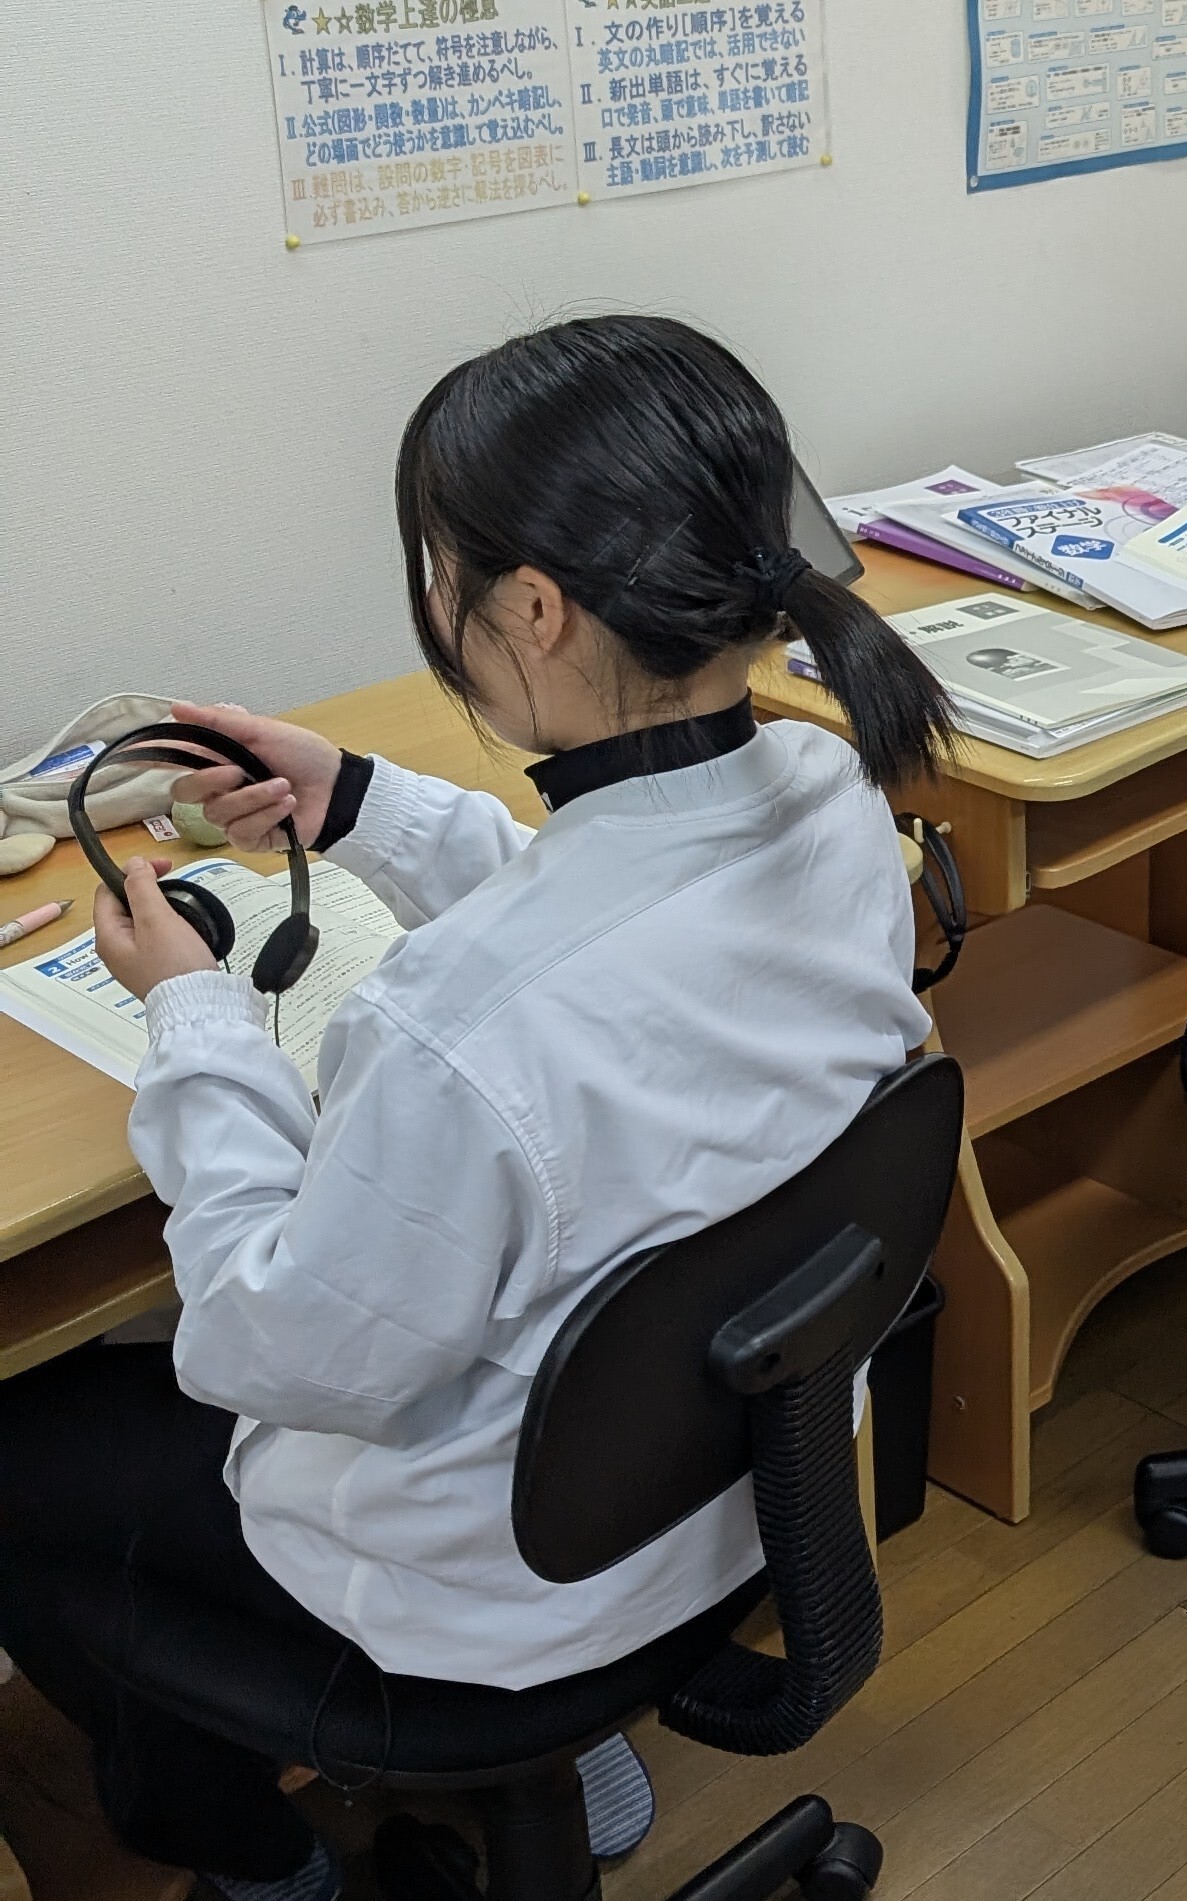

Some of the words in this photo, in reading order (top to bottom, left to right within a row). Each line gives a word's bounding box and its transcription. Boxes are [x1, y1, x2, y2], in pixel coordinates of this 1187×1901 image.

[998, 507, 1101, 527] ファイナル
[1016, 516, 1103, 538] ステージ
